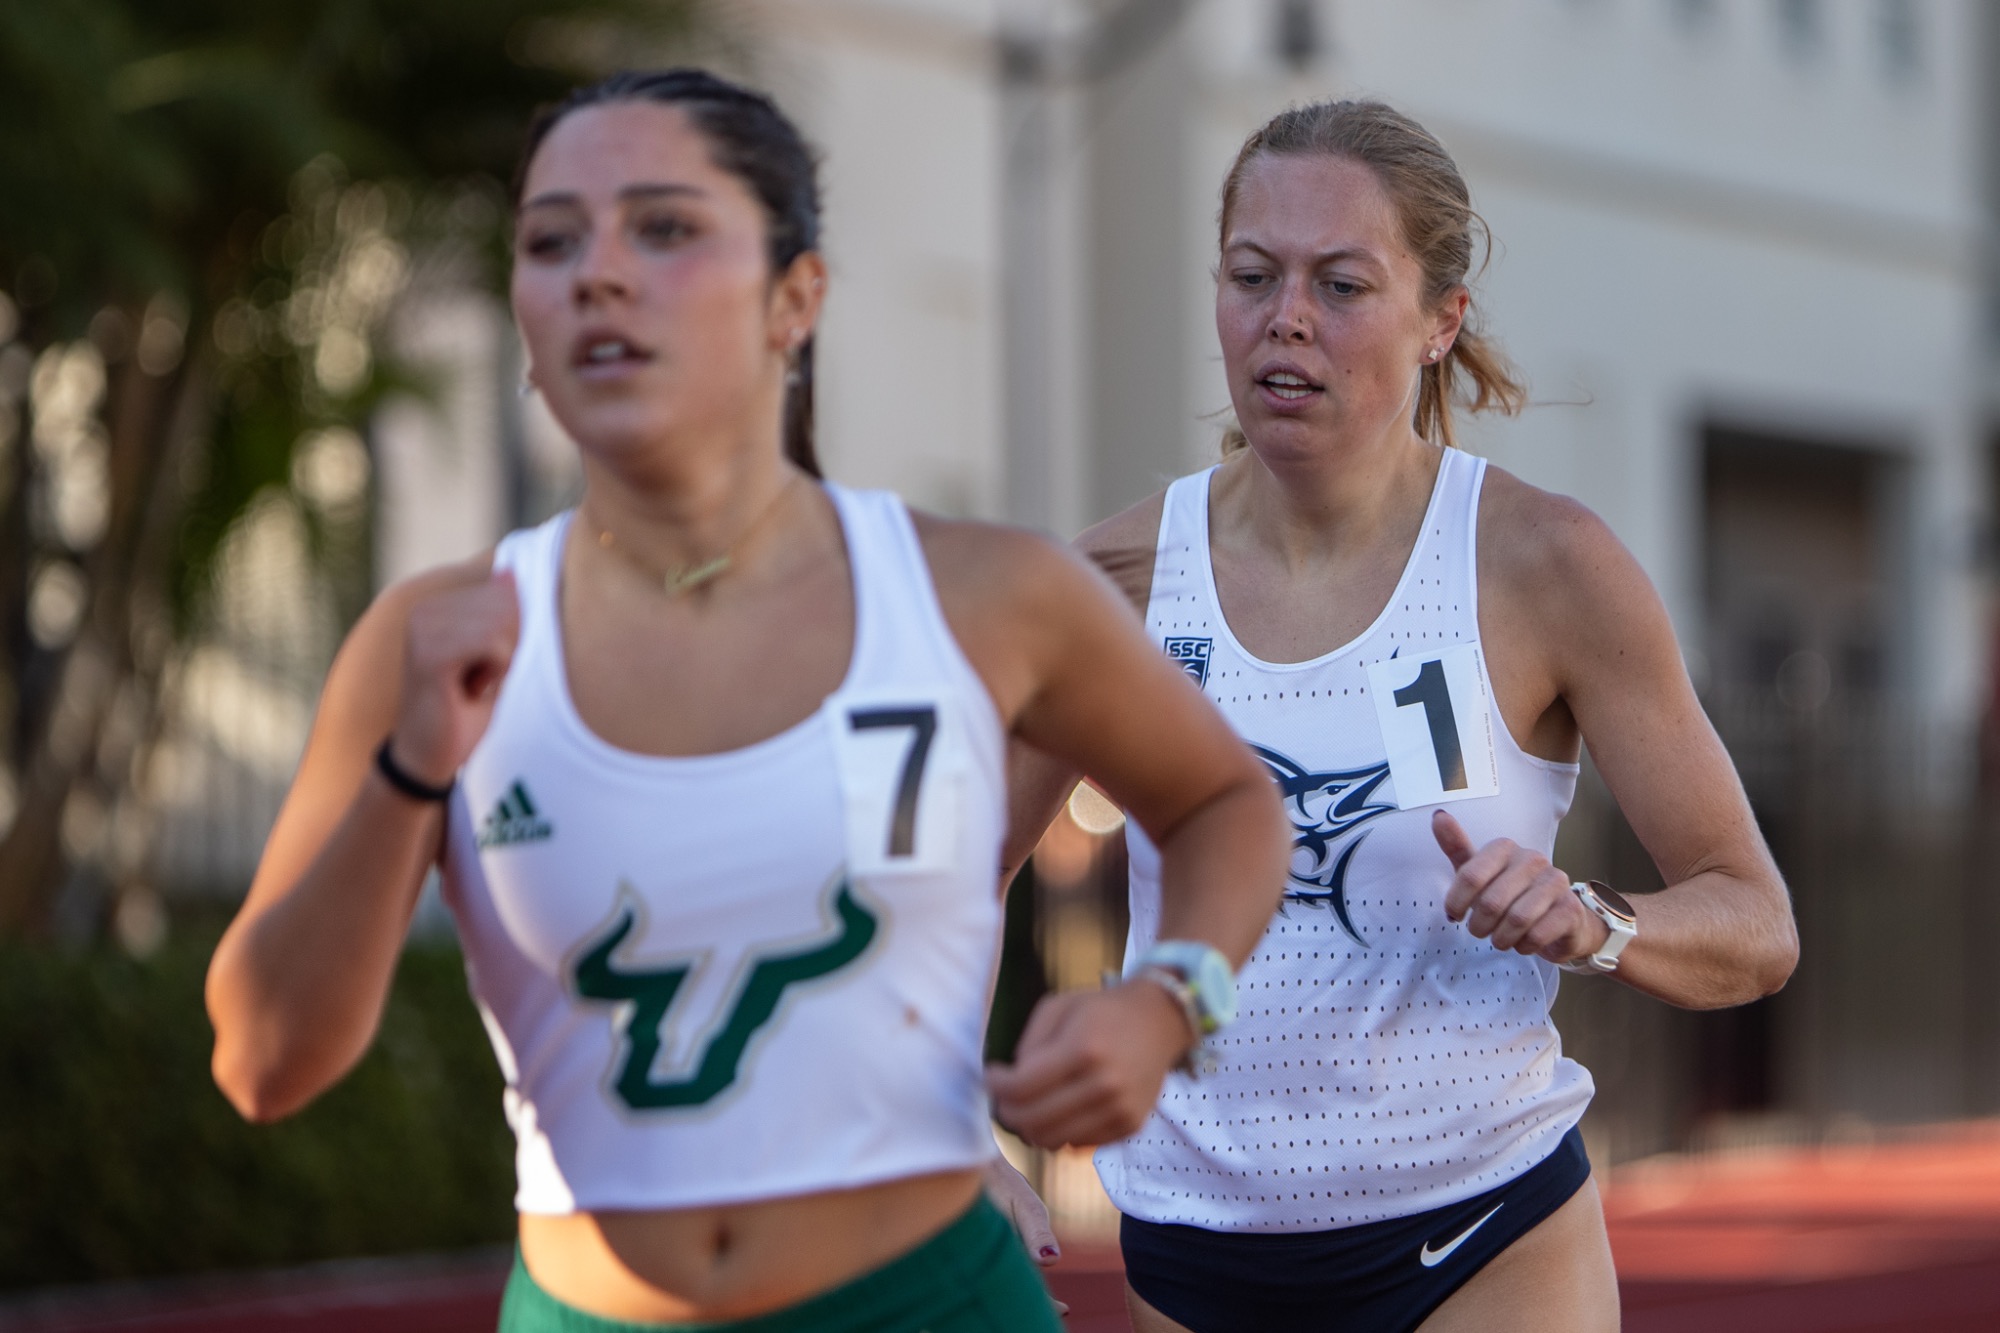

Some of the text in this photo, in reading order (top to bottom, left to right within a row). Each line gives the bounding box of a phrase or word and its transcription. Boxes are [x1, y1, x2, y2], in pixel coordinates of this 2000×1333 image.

[1168, 641, 1208, 658] SSC
[847, 703, 938, 858] 7
[1393, 659, 1468, 791] 1
